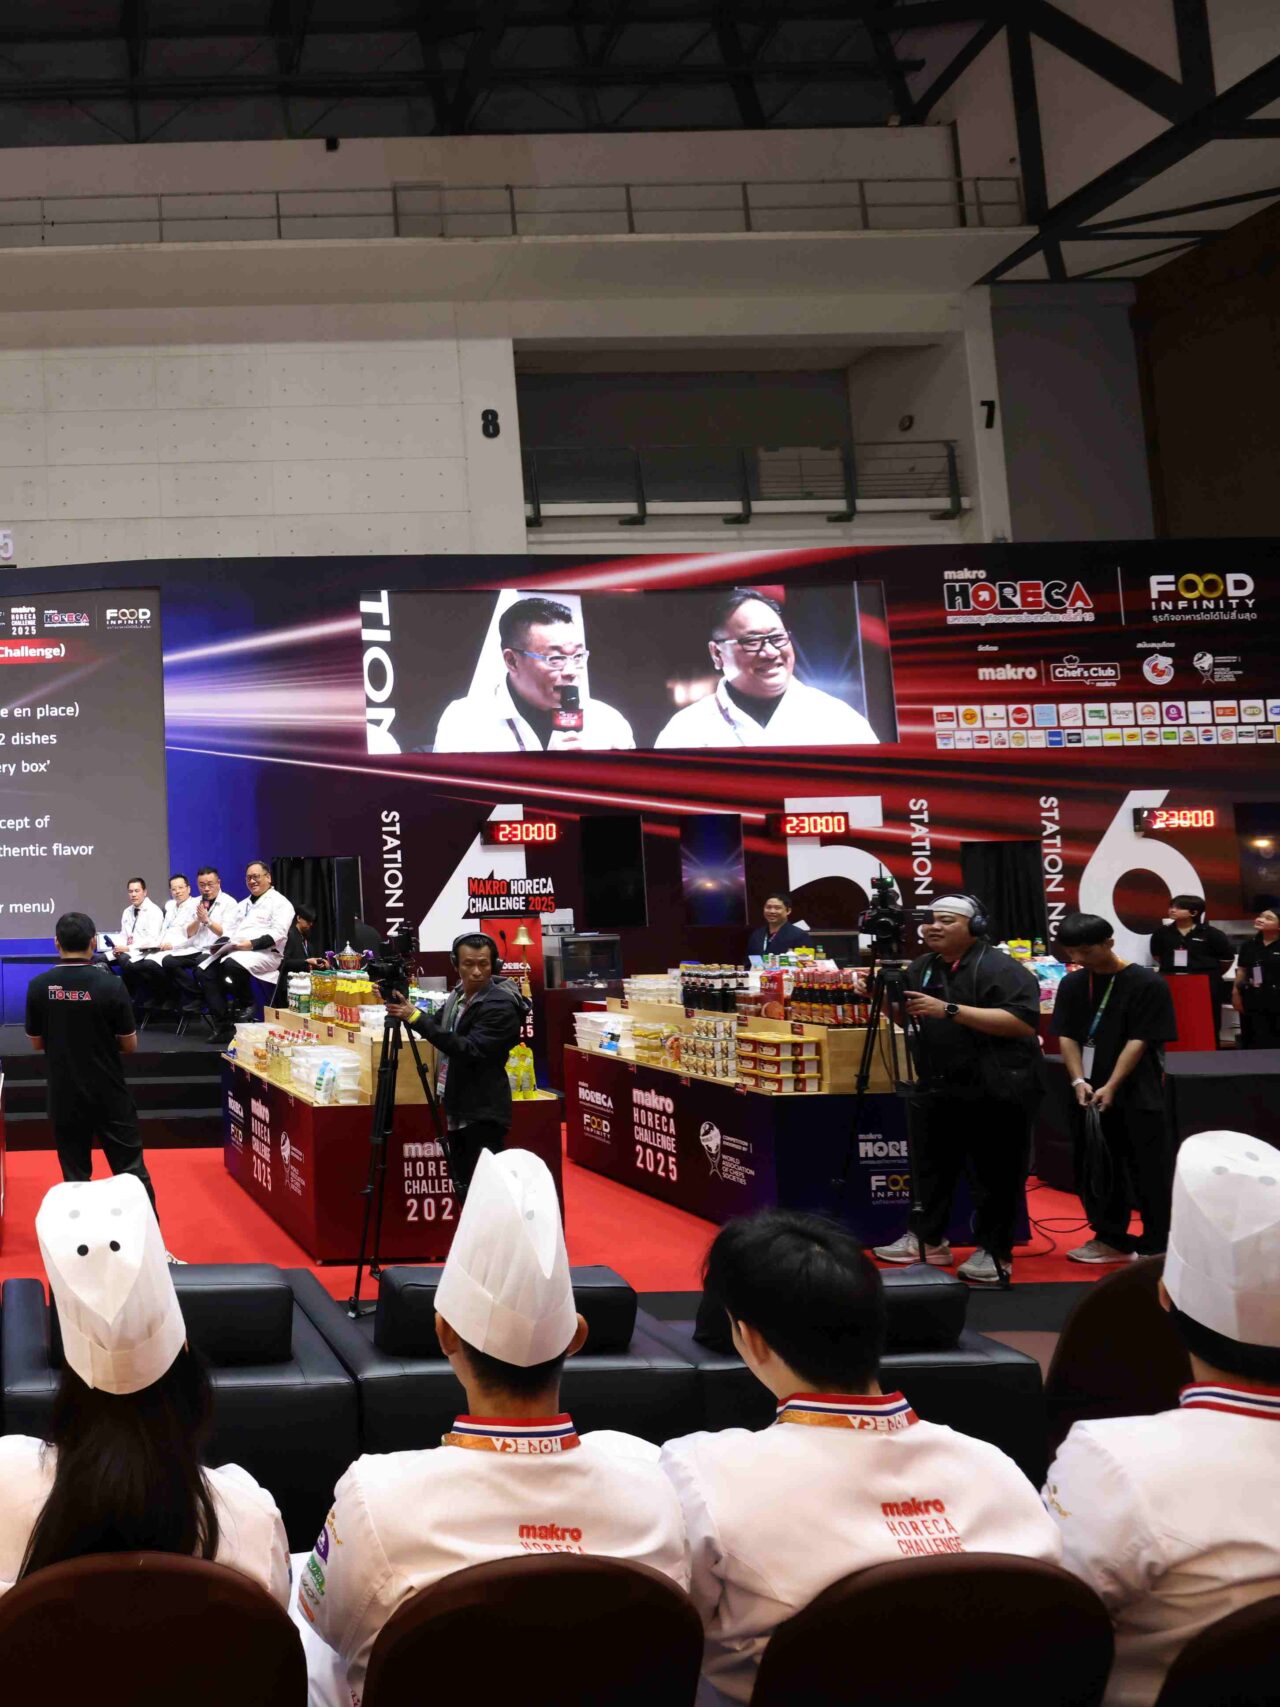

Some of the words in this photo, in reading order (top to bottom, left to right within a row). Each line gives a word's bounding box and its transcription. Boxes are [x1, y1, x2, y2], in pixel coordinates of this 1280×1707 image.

[480, 409, 499, 439] 8
[980, 400, 995, 429] 7
[943, 568, 987, 581] makro
[943, 580, 1093, 611] HORECA
[1149, 573, 1255, 600] FOOD
[105, 608, 152, 620] FOOD
[1151, 599, 1256, 611] INFINITY
[11, 626, 37, 636] 2025
[978, 663, 1038, 682] makro
[1054, 666, 1090, 679] Chef's
[1091, 666, 1116, 678] Club
[13, 706, 32, 718] en
[36, 701, 80, 720] place)
[11, 731, 58, 746] dishes
[34, 814, 51, 829] of
[51, 842, 94, 856] flavor
[909, 798, 934, 896] STATION
[1039, 796, 1065, 893] STATION
[380, 810, 404, 908] STATION
[418, 803, 528, 953] 4
[468, 877, 508, 896] MAKRO
[510, 877, 555, 895] HORECA
[1078, 789, 1207, 967] 6
[9, 897, 55, 914] menu)
[469, 896, 526, 914] CHALLENGE
[528, 896, 557, 913] 2025
[578, 1087, 614, 1109] HORECA
[631, 1087, 675, 1114] makro
[583, 1113, 611, 1133] FOOD
[632, 1106, 676, 1136] HORECA
[633, 1125, 677, 1154] CHALLENGE
[252, 1155, 272, 1192] 2025
[403, 1160, 448, 1178] HORE
[635, 1145, 678, 1182] 2025
[404, 1178, 456, 1194] CHALLEN
[406, 1197, 454, 1221] 202
[880, 1497, 946, 1518] makro
[518, 1523, 583, 1543] makro
[885, 1517, 958, 1537] HORECA
[897, 1536, 966, 1556] CHALLENGE
